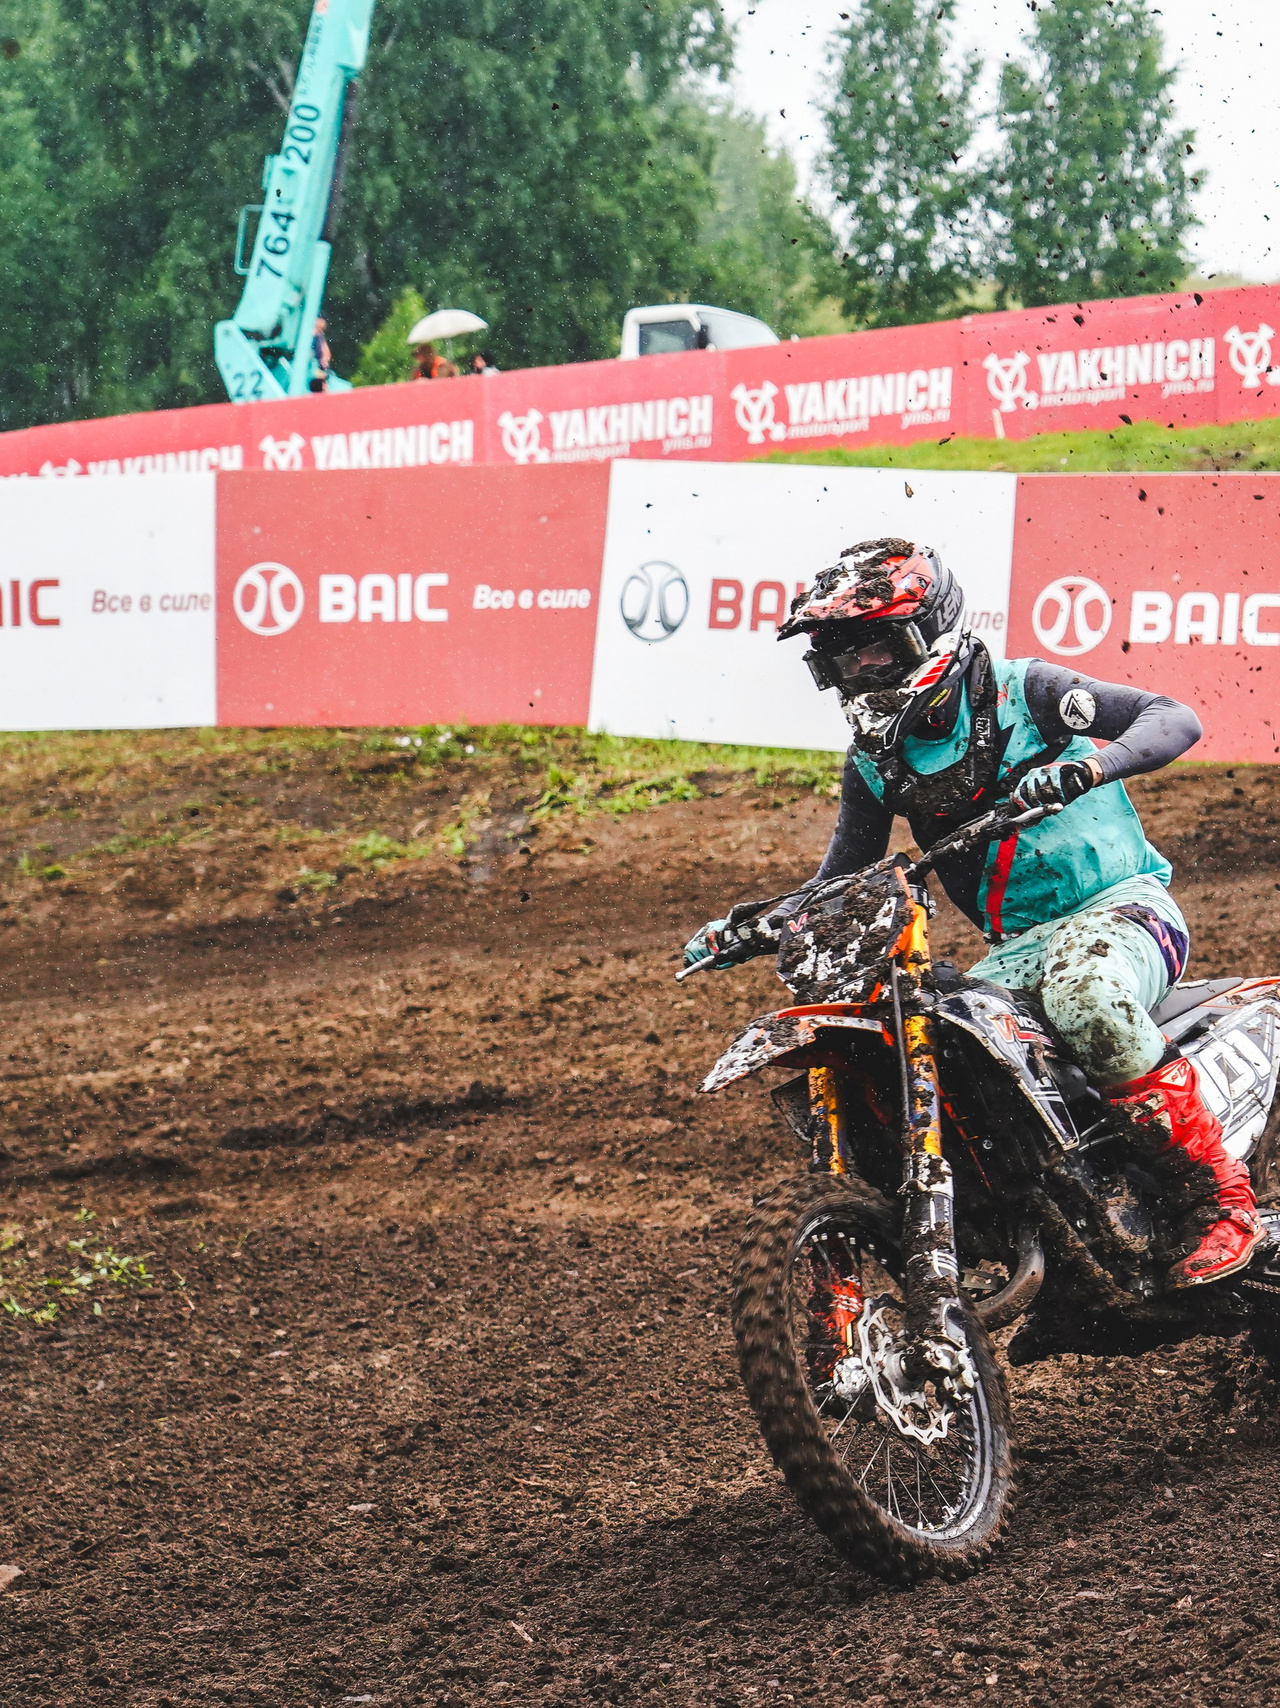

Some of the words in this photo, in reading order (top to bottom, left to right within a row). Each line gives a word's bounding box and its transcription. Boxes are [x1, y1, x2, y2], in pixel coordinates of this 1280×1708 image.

[256, 209, 296, 277] 764
[284, 104, 321, 165] 200
[1037, 337, 1215, 393] YAKHNICH
[549, 395, 713, 448] YAKHNICH
[784, 366, 952, 425] YAKHNICH
[311, 419, 473, 470] YAKHNICH
[0, 580, 60, 626] IC
[92, 590, 132, 612] Все
[159, 593, 211, 611] силе
[319, 573, 449, 623] BAIC
[472, 584, 515, 610] Все
[518, 590, 533, 609] в
[537, 588, 591, 609] силе
[708, 579, 803, 632] BA
